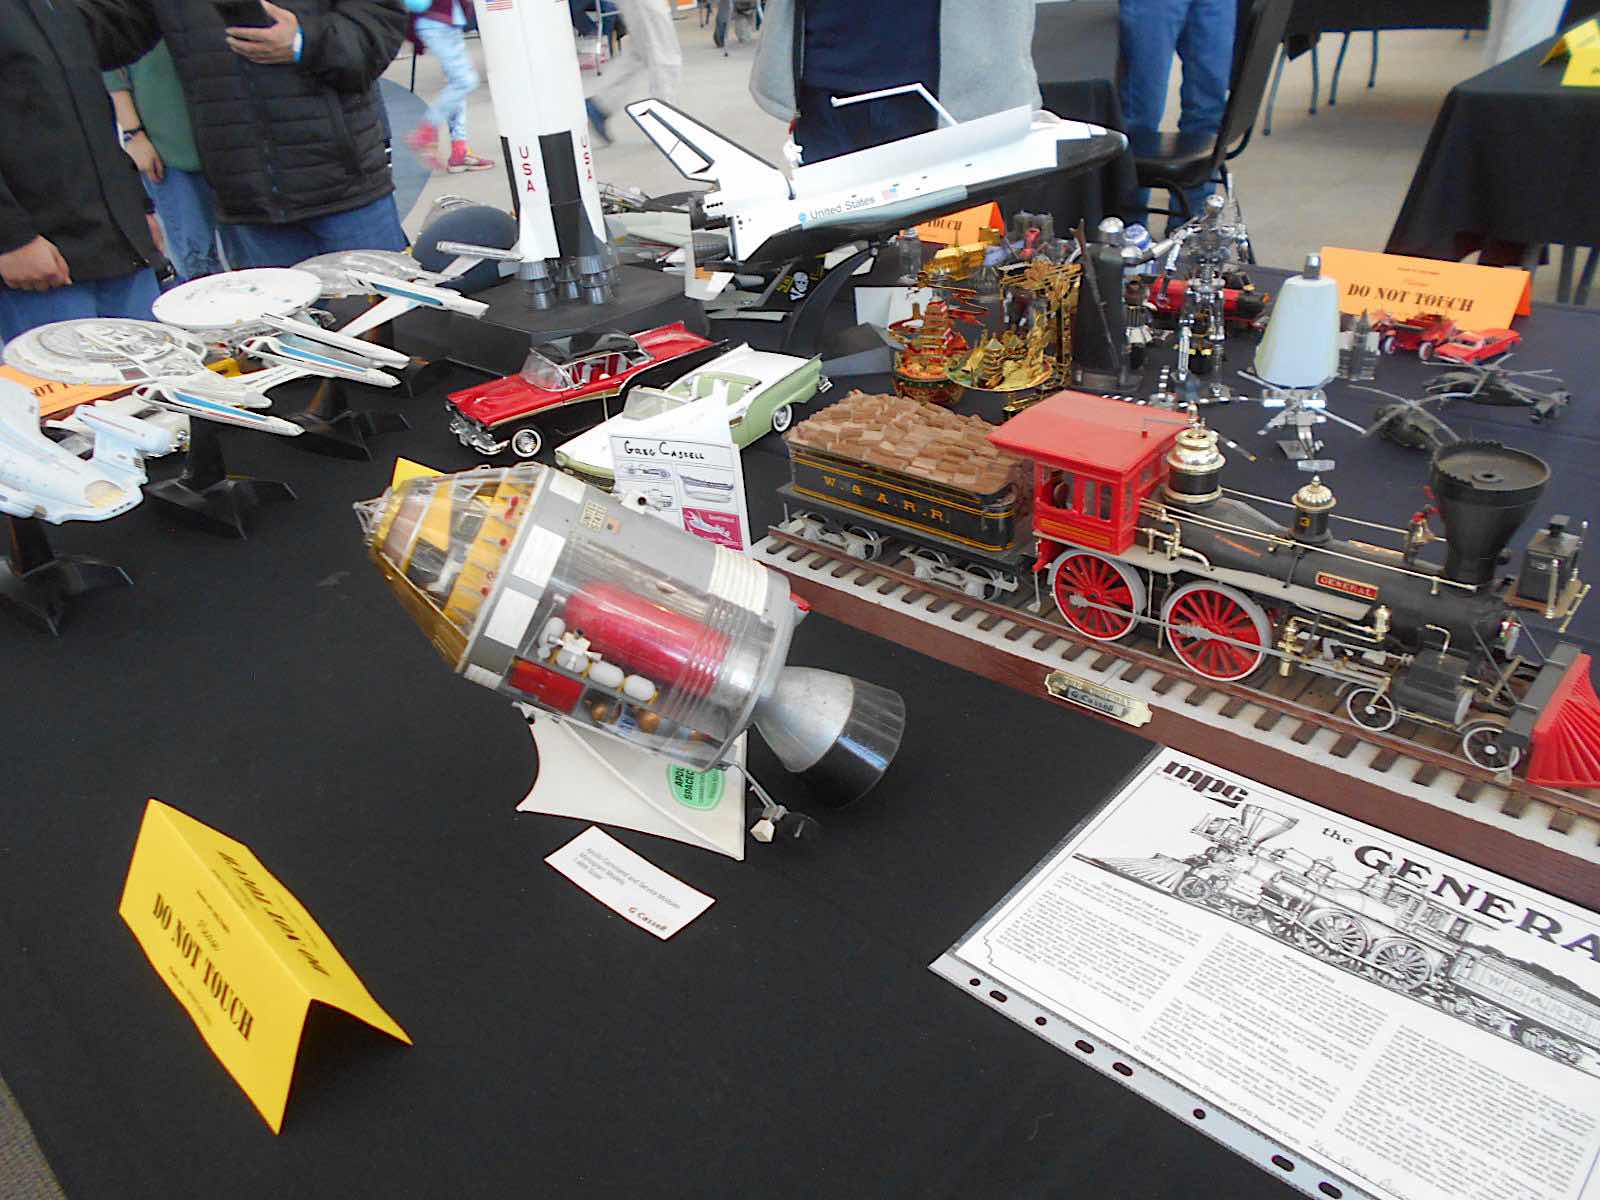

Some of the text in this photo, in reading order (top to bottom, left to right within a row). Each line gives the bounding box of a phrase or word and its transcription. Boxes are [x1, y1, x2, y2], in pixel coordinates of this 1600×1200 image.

[518, 145, 536, 193] USA
[810, 196, 875, 220] United States
[1347, 283, 1475, 313] DO NOT TOUCH
[1163, 761, 1248, 802] mpc
[1321, 827, 1353, 846] the
[152, 893, 172, 930] DO
[171, 919, 203, 968] NOT
[201, 958, 254, 1041] TOUCH
